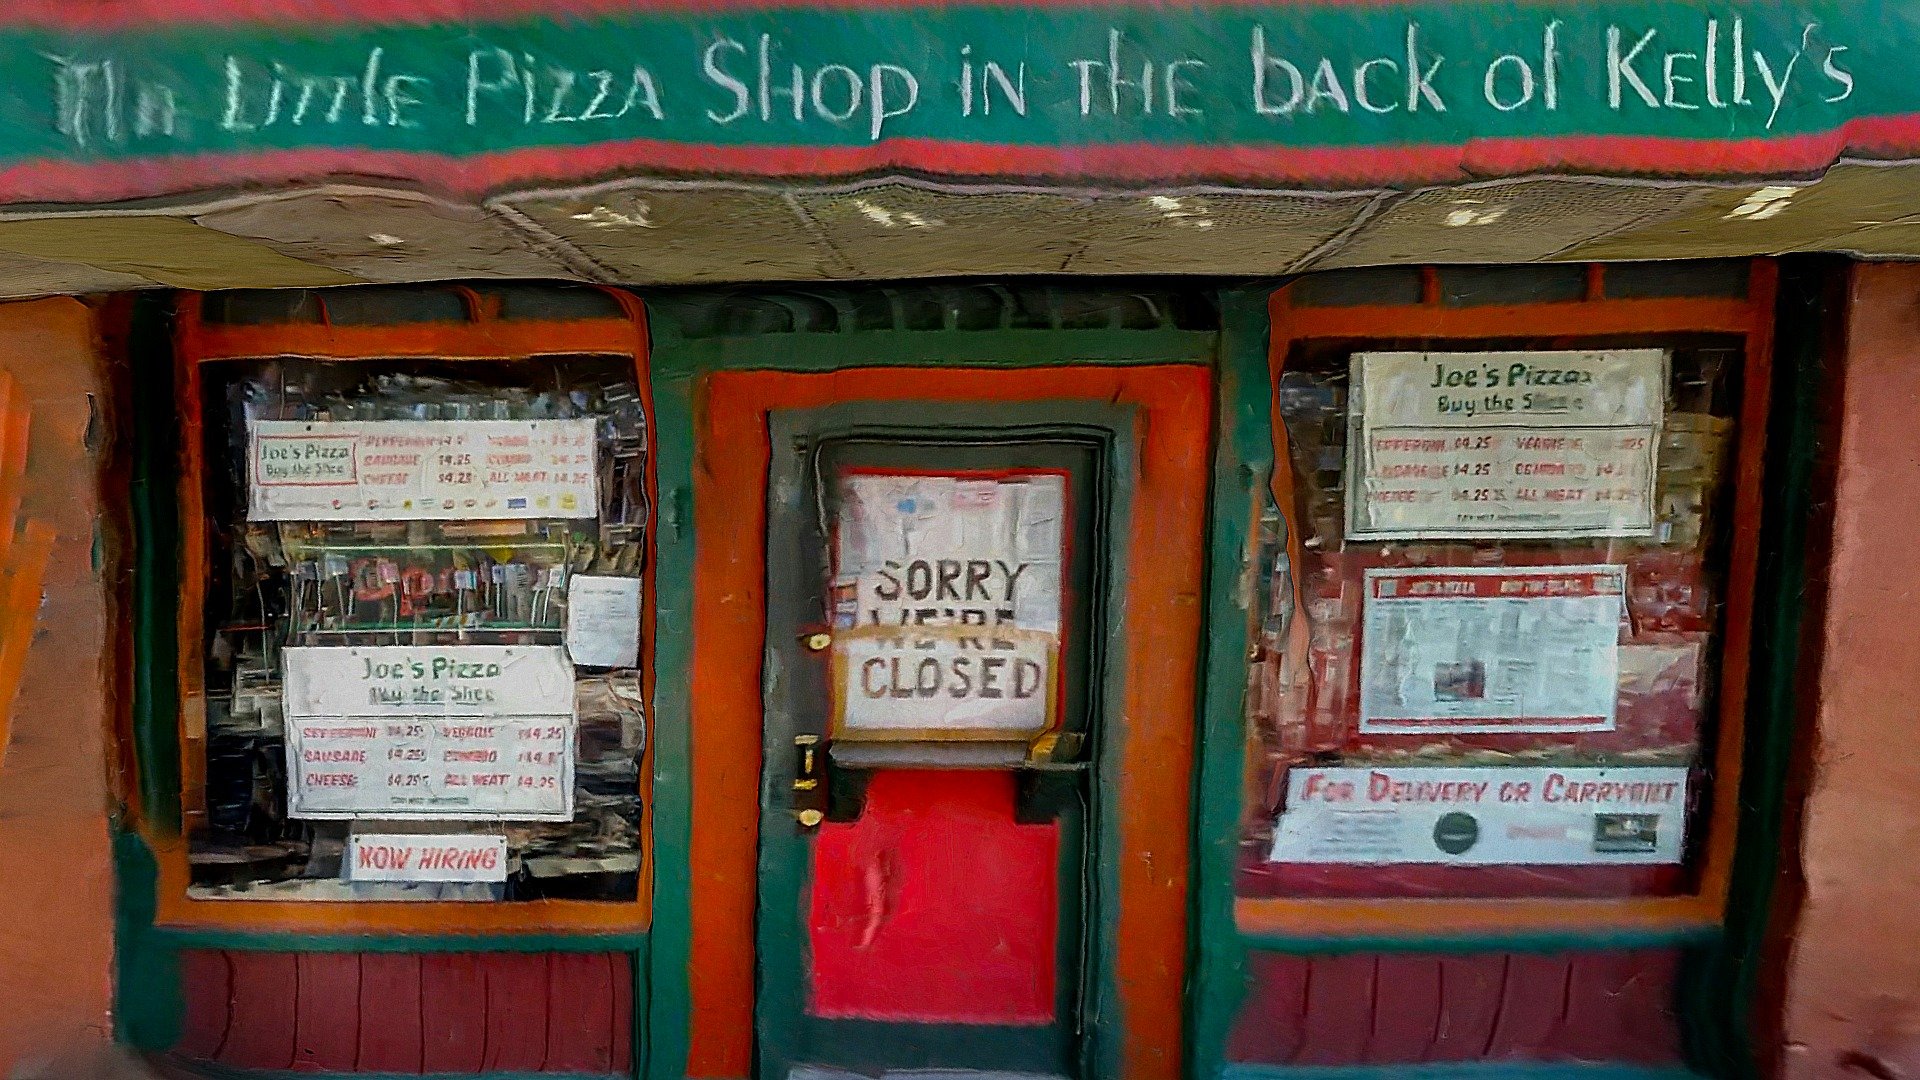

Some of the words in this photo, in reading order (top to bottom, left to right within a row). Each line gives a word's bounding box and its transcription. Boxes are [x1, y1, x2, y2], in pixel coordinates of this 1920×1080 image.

[1430, 363, 1499, 388] Joe's
[1438, 394, 1476, 417] Buy
[1485, 394, 1514, 411] the
[304, 443, 349, 460] Pizza
[874, 559, 1029, 601] SORRY
[362, 656, 424, 679] Joe's
[432, 656, 500, 679] Pizza
[861, 656, 1041, 699] CLOSED
[359, 846, 412, 870] NOW
[418, 846, 498, 870] HIRING
